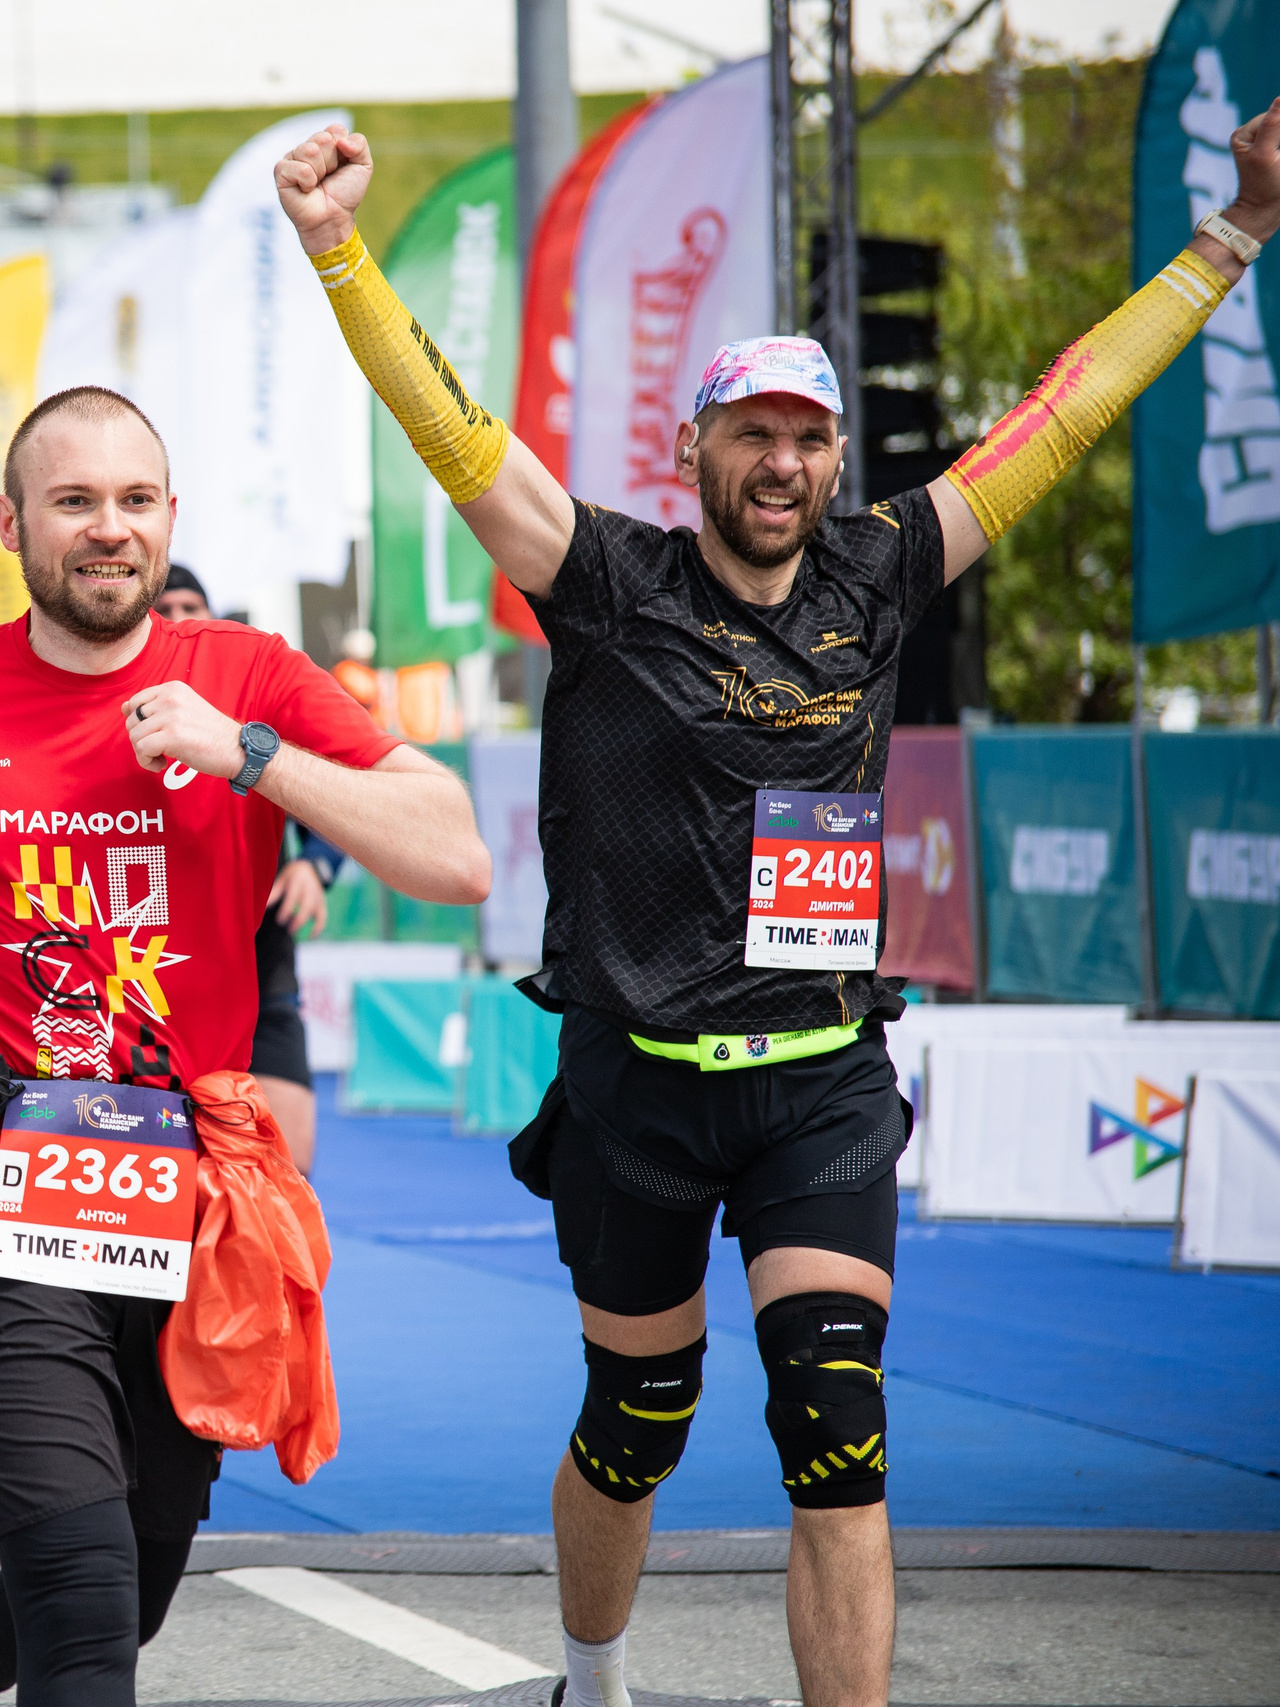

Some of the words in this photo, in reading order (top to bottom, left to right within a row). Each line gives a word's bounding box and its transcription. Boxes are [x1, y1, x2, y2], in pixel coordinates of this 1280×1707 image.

[422, 333, 441, 373] HARD
[811, 635, 859, 654] NORDSKI
[835, 689, 863, 702] БАНК
[774, 713, 841, 728] МАРАФОН
[0, 808, 165, 836] МАРАФОН
[783, 847, 874, 890] 2402
[752, 899, 774, 910] 2024
[808, 899, 855, 913] ДМИТРИЙ
[2, 1164, 23, 1188] D
[34, 1143, 179, 1204] 2363
[75, 1208, 127, 1226] АНТОН
[831, 1322, 864, 1331] DEMIX
[651, 1378, 683, 1388] DEMIX
